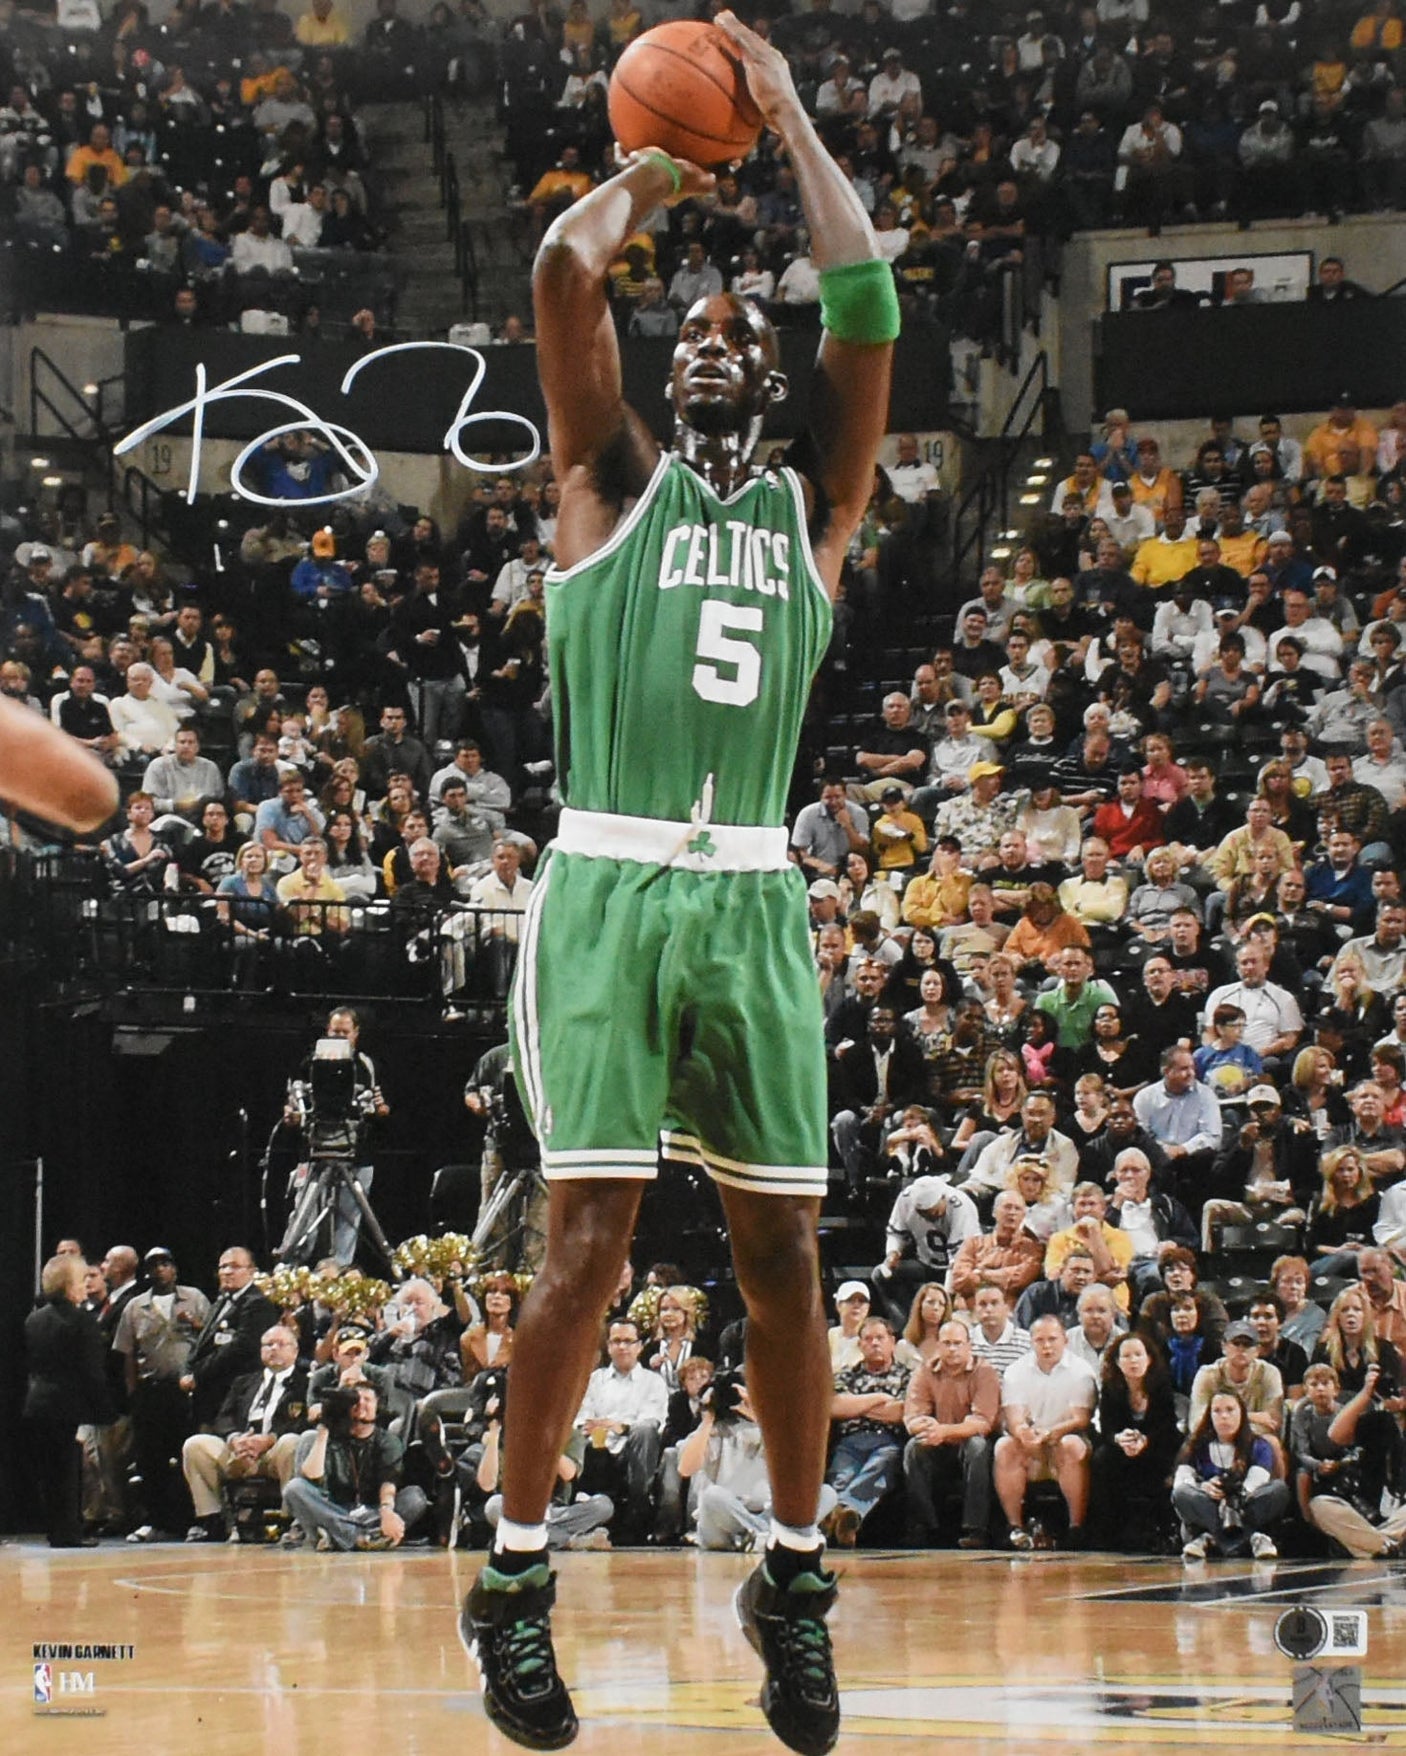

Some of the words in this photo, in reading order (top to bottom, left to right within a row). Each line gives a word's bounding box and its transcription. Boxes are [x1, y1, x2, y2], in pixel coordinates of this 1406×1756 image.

[152, 444, 171, 474] 19
[924, 440, 944, 471] 19
[658, 520, 789, 601] CELTICS
[692, 599, 763, 707] 5
